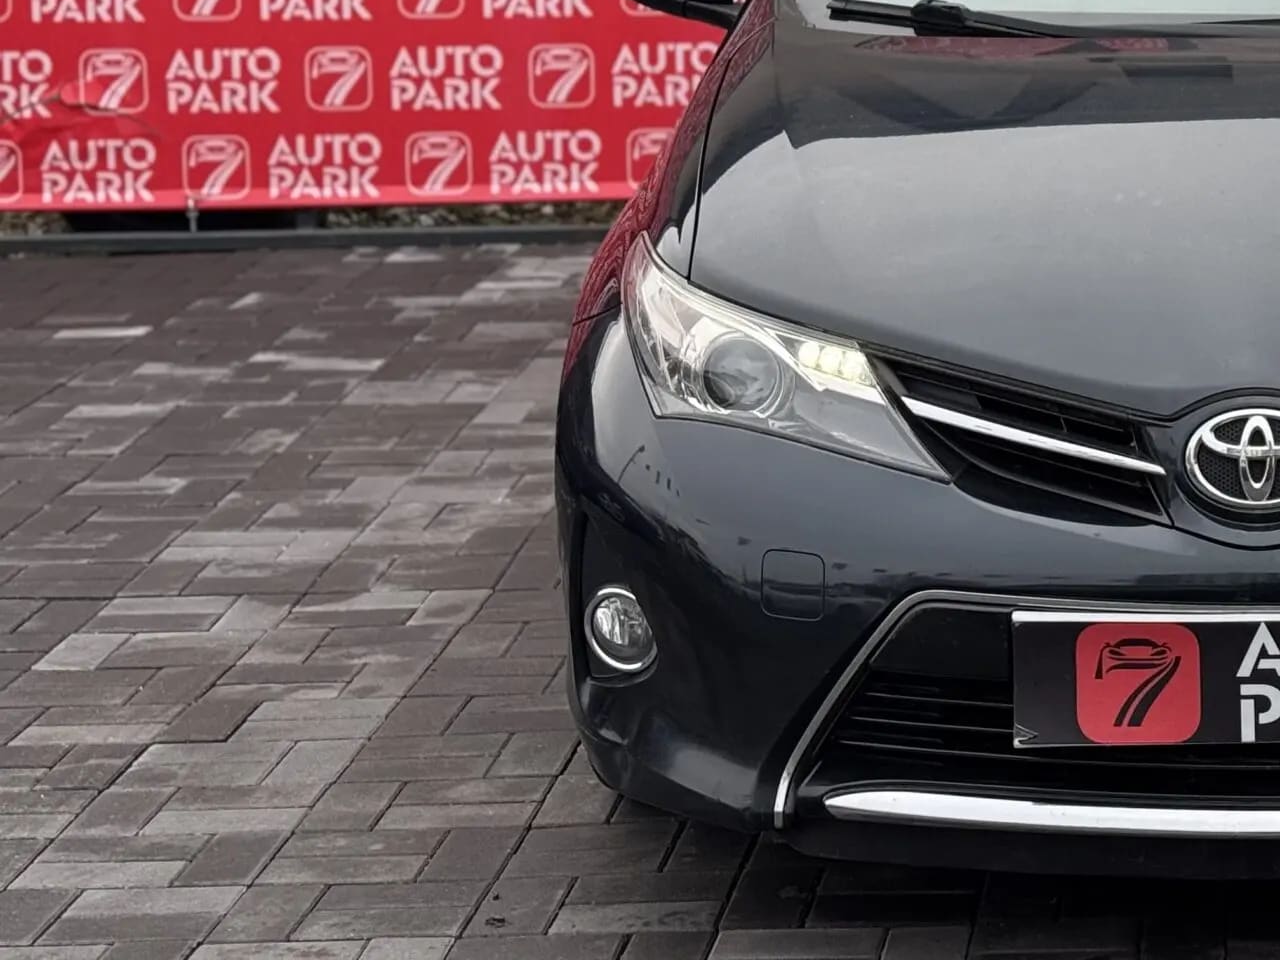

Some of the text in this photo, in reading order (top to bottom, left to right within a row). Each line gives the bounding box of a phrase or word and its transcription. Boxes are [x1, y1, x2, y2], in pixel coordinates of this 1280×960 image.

[166, 47, 280, 81] AUTO
[390, 45, 503, 78] AUTO
[168, 80, 279, 113] PARK
[392, 77, 501, 110] PARK
[41, 139, 156, 171] AUTO
[268, 133, 381, 166] AUTO
[490, 130, 601, 163] AUTO
[43, 171, 154, 203] PARK
[268, 165, 381, 201] PARK
[490, 164, 601, 198] PARK
